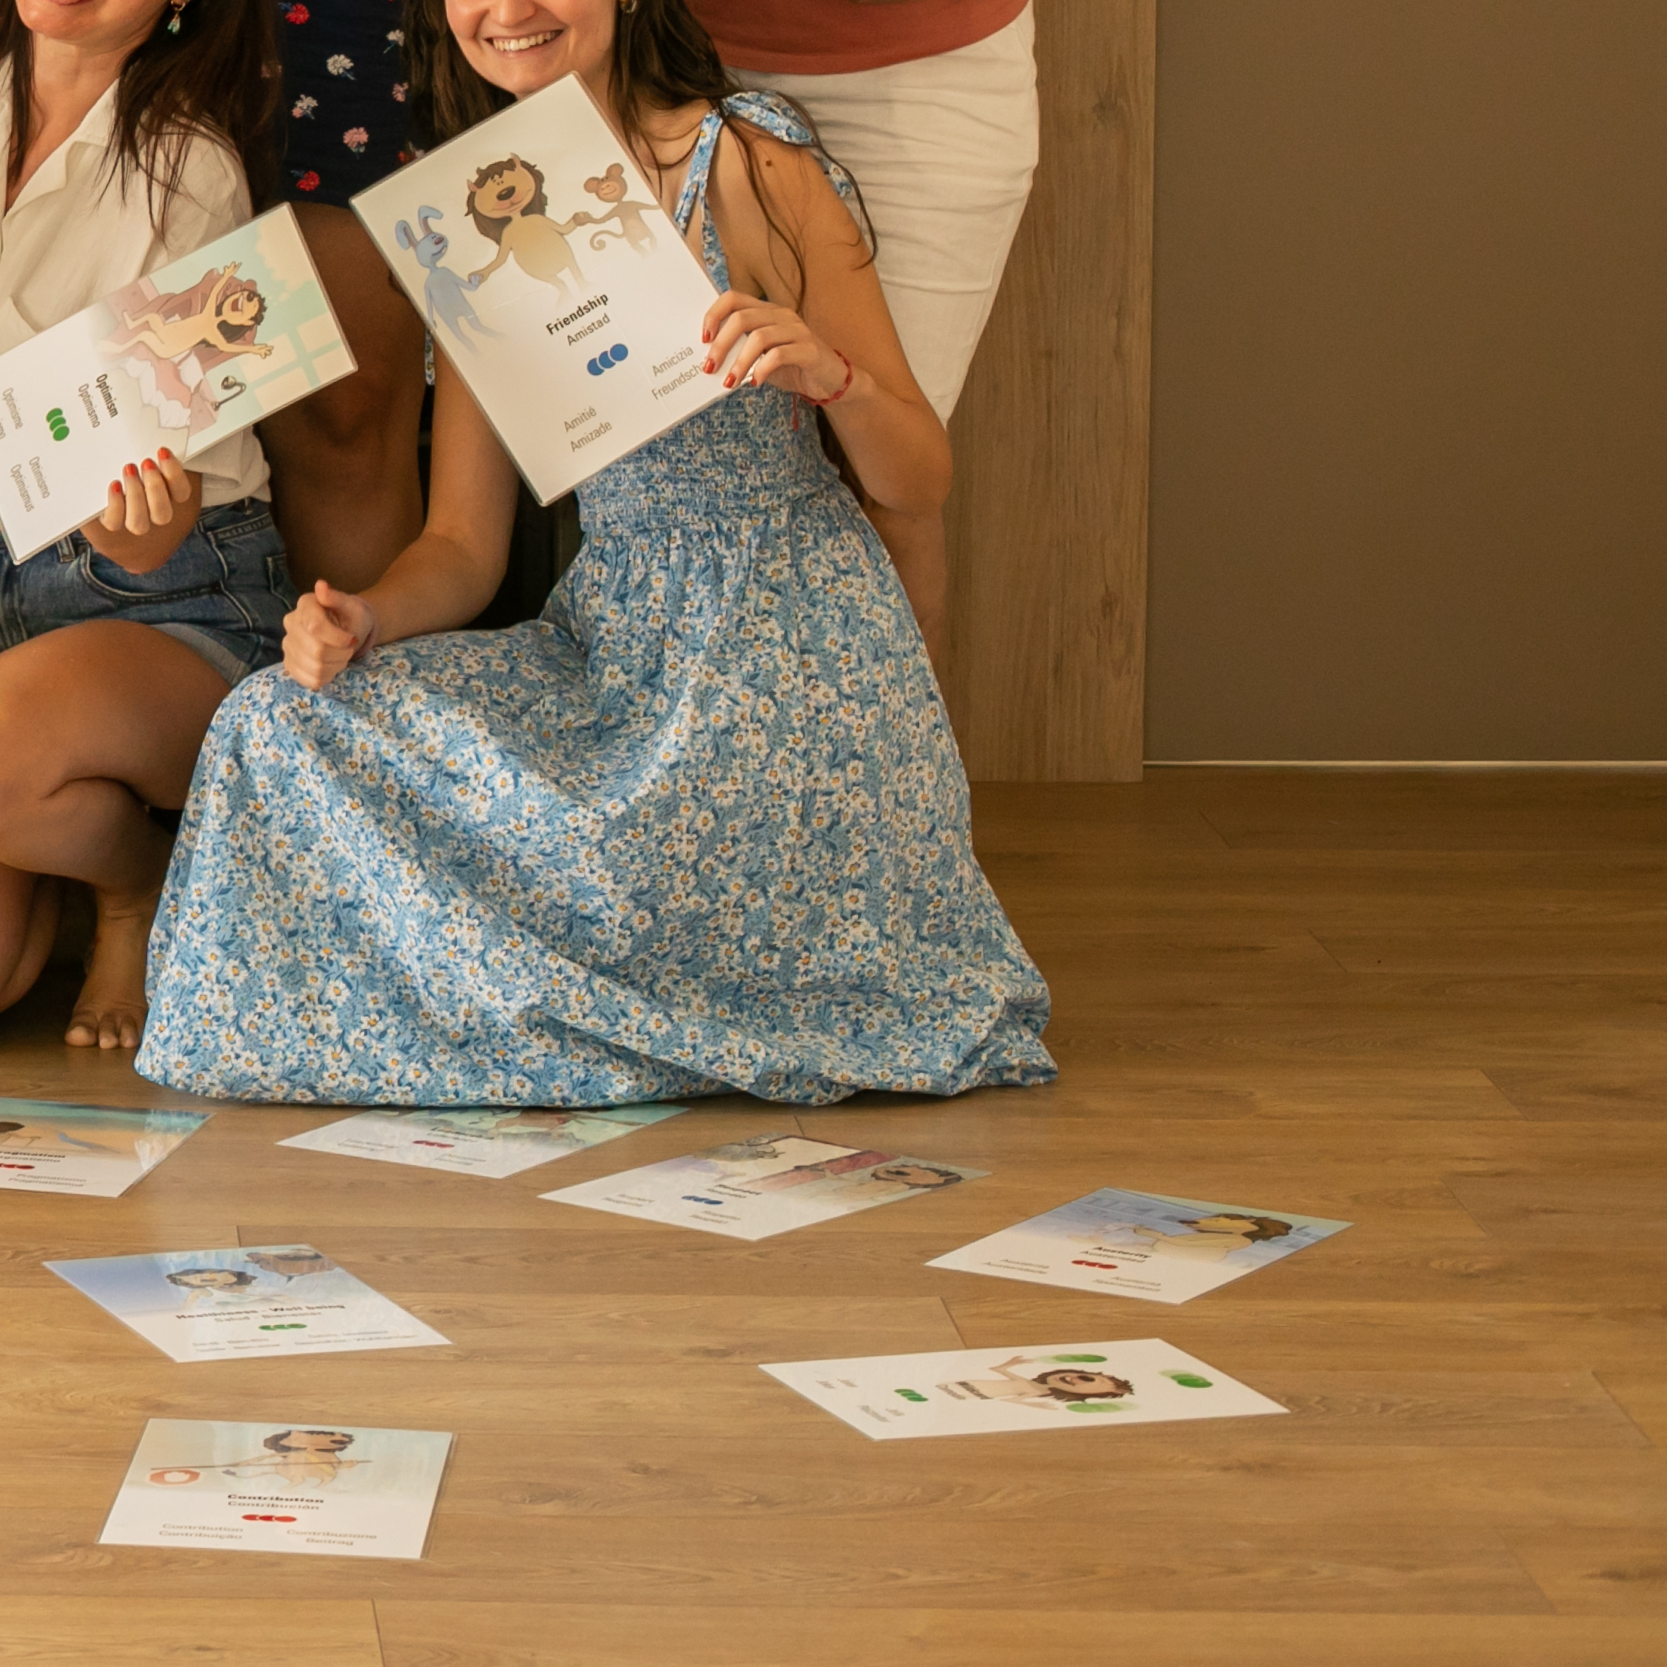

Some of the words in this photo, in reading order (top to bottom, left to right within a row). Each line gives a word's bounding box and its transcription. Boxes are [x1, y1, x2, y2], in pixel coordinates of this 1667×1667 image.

[544, 292, 610, 336] Friendship
[566, 312, 611, 347] Amistad
[651, 344, 694, 378] Amicizia
[2, 386, 24, 430] Optimisme
[77, 383, 101, 429] Optimismo
[95, 373, 119, 419] Optimism
[563, 405, 597, 434] Amitié
[569, 419, 613, 453] Amizade
[9, 463, 35, 514] Optimismus
[28, 456, 51, 500] Ottimismo
[226, 1493, 325, 1504] Contribution
[226, 1501, 320, 1510] Contribución
